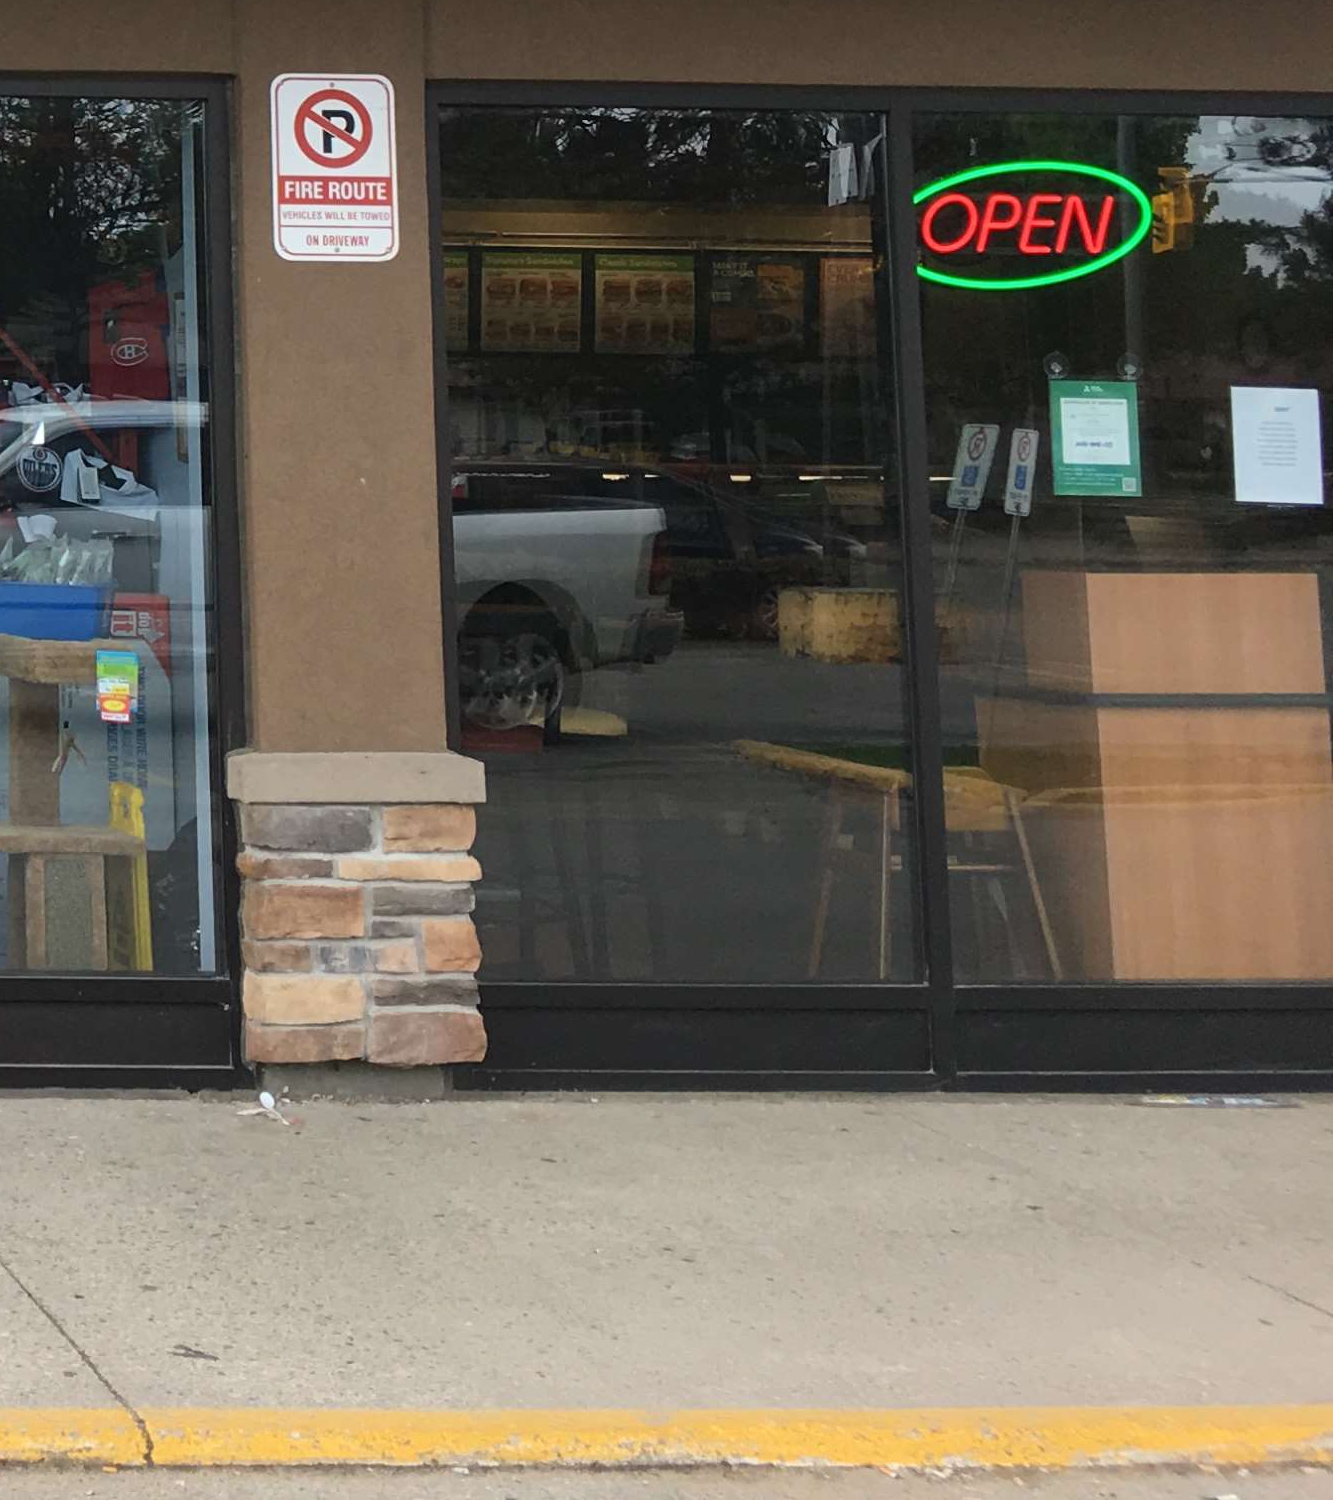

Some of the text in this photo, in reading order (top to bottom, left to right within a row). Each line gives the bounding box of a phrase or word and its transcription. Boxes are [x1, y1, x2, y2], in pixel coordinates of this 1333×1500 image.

[284, 181, 388, 200] FIRE ROUTE
[282, 211, 390, 222] VEHICLES WILL BE TOWED
[920, 192, 1115, 255] OPEN
[306, 234, 370, 247] ON DRIVEWAY
